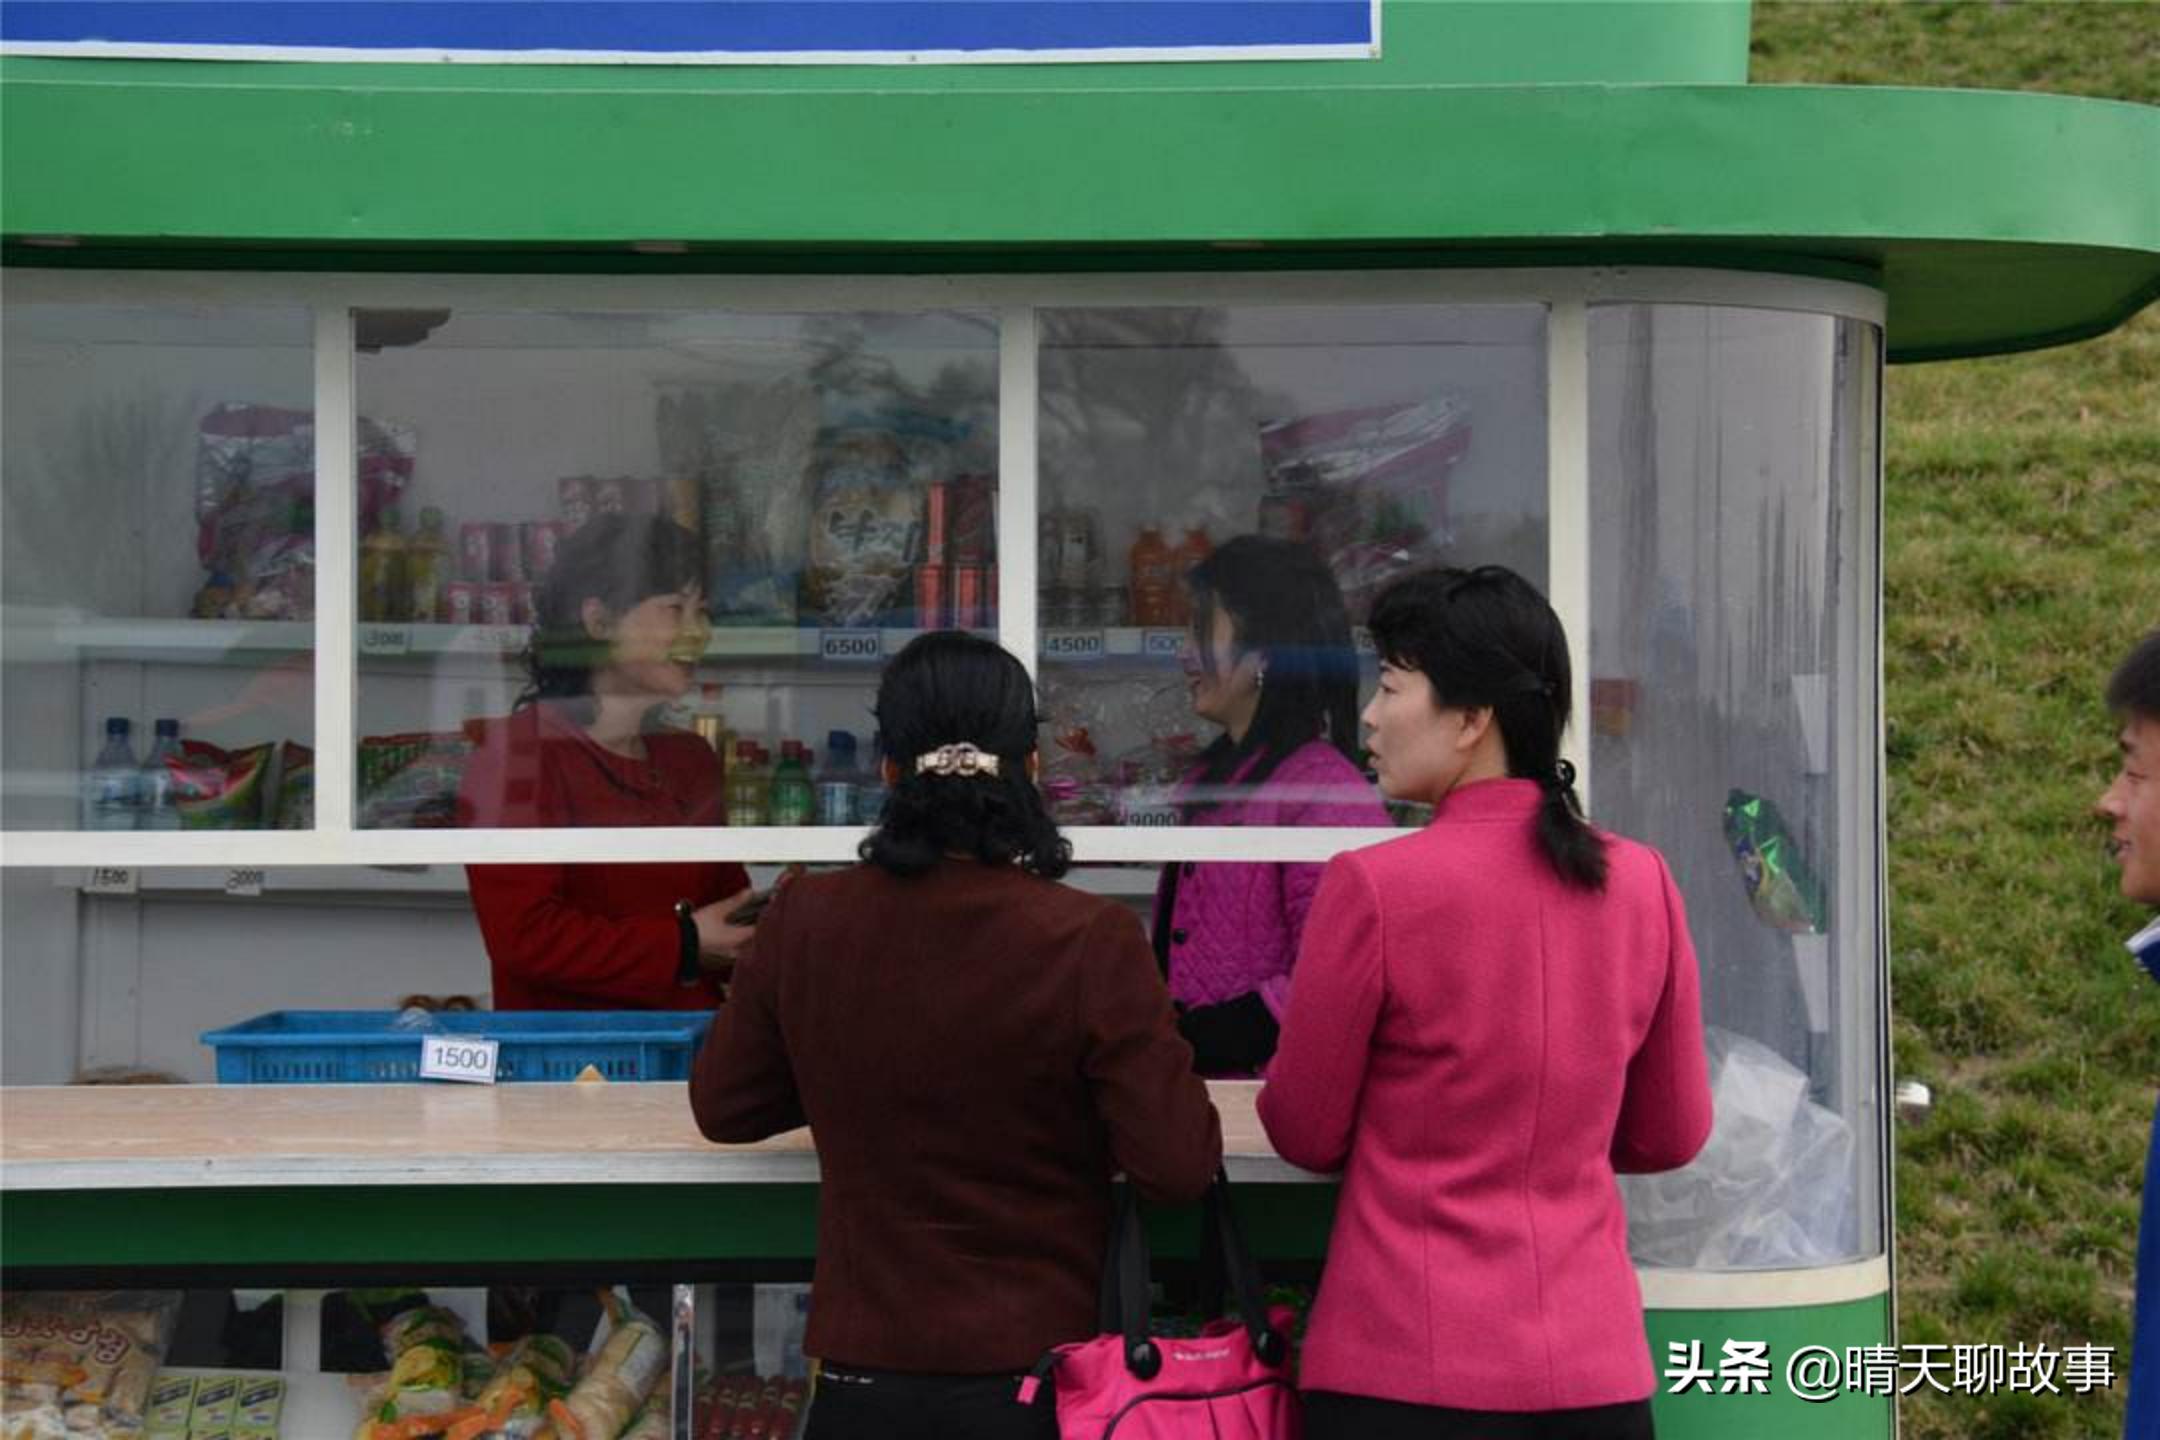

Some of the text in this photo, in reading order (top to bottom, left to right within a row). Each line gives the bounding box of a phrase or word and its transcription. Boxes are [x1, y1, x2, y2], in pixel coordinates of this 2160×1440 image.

[824, 638, 877, 656] 6500
[1049, 636, 1099, 652] 4500
[436, 1046, 488, 1069] 1500
